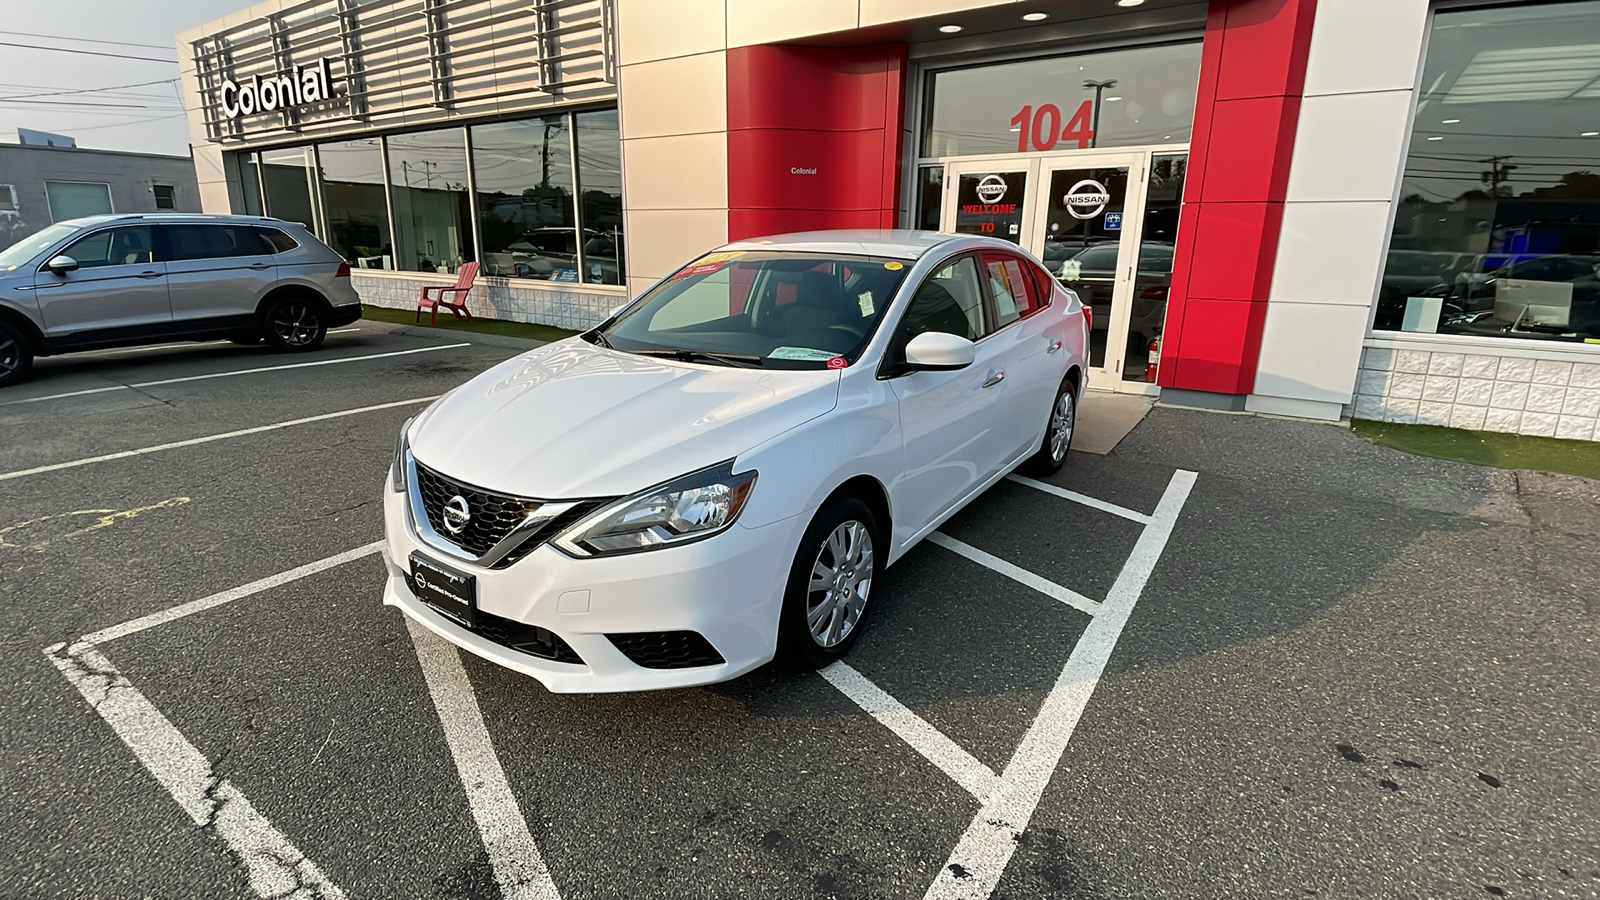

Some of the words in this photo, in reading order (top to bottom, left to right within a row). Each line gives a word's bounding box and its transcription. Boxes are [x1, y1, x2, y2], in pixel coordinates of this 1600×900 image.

[221, 57, 330, 118] Colonial
[1010, 100, 1094, 152] 104
[790, 167, 817, 175] Colonial
[1067, 196, 1106, 204] NISSAN
[962, 204, 1017, 214] WELCOME
[980, 222, 995, 232] TO
